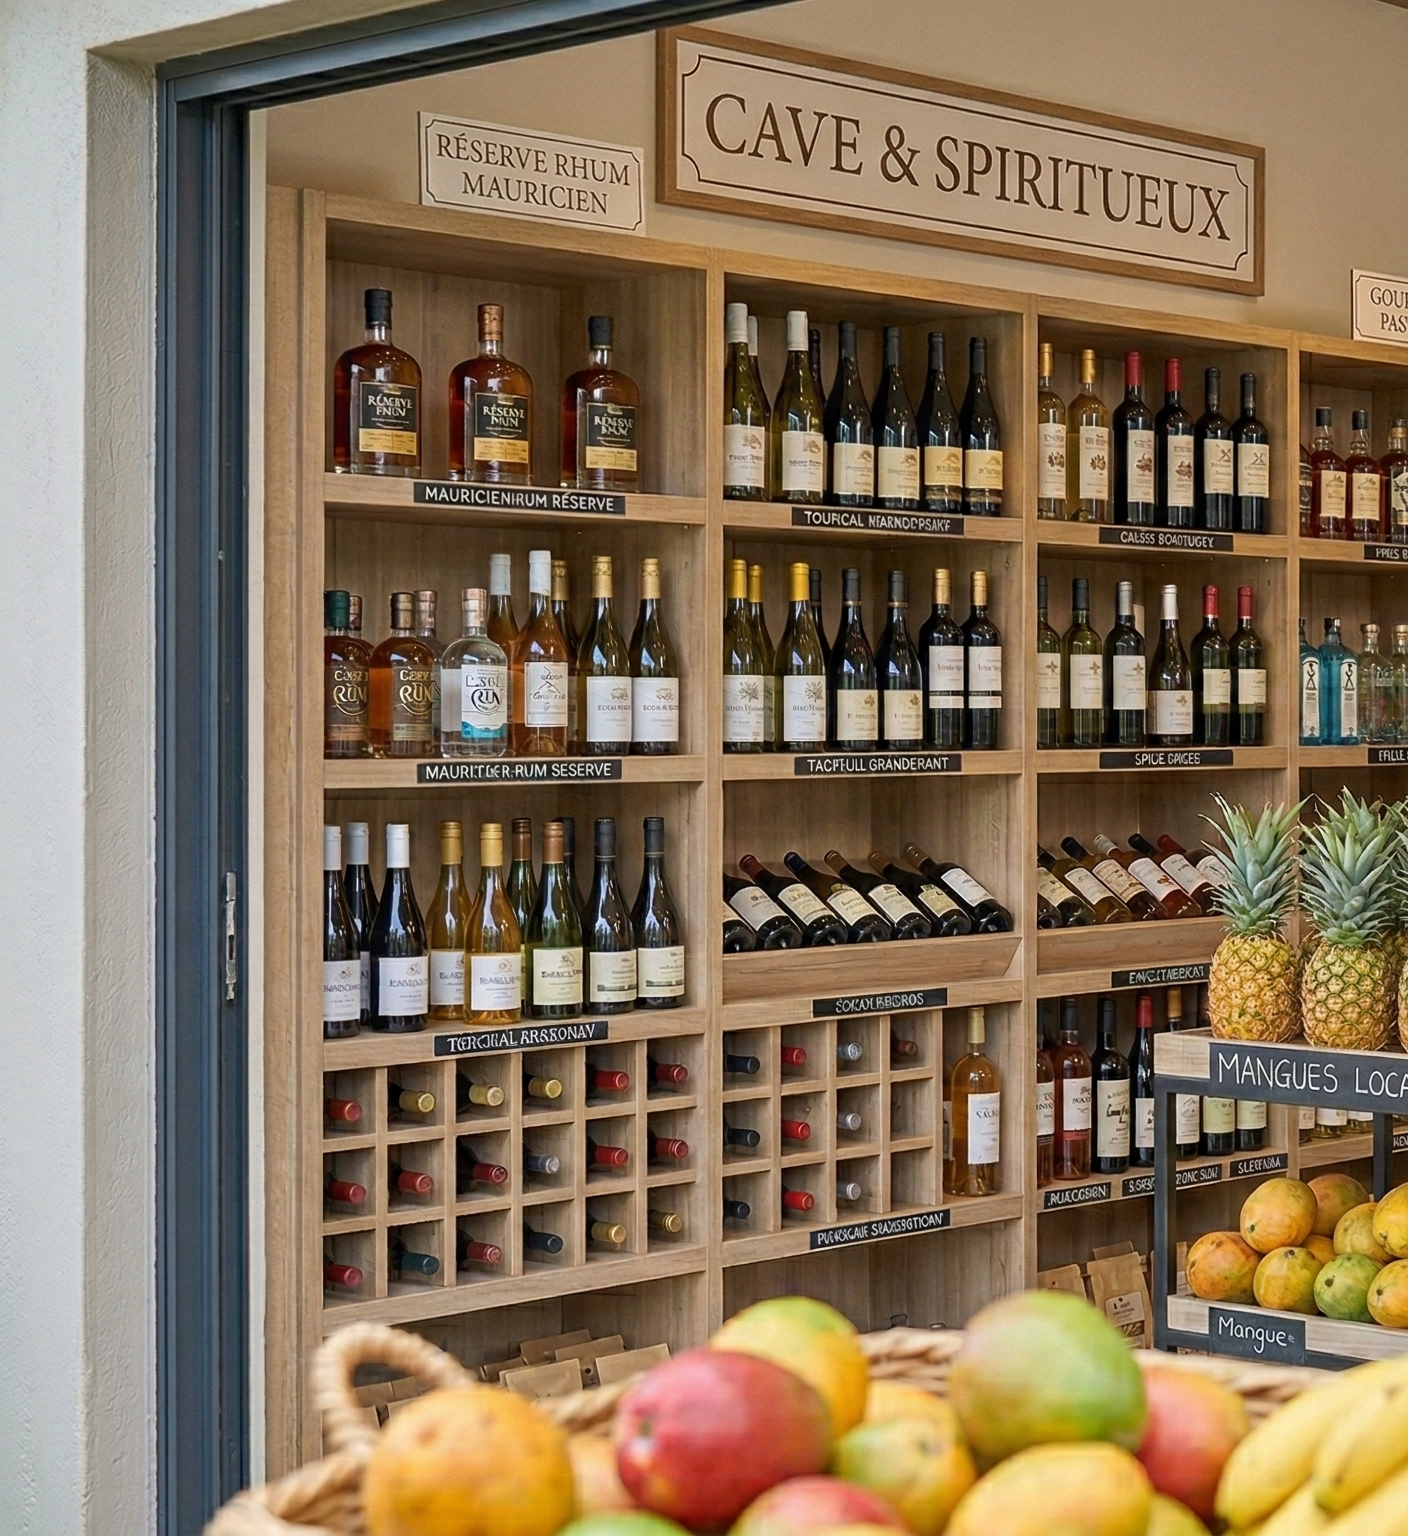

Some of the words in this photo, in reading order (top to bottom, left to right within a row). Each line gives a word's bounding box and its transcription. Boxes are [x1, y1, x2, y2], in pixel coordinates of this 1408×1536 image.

[436, 133, 548, 174] RÉSERVE
[554, 153, 631, 186] RHUM
[705, 93, 864, 176] CAVE
[880, 125, 922, 187] &
[934, 135, 1232, 242] SPIRITUEUX
[461, 171, 608, 216] MAURICIEN
[552, 492, 614, 511] RÉSERVE
[1218, 1052, 1338, 1094] MANGUES
